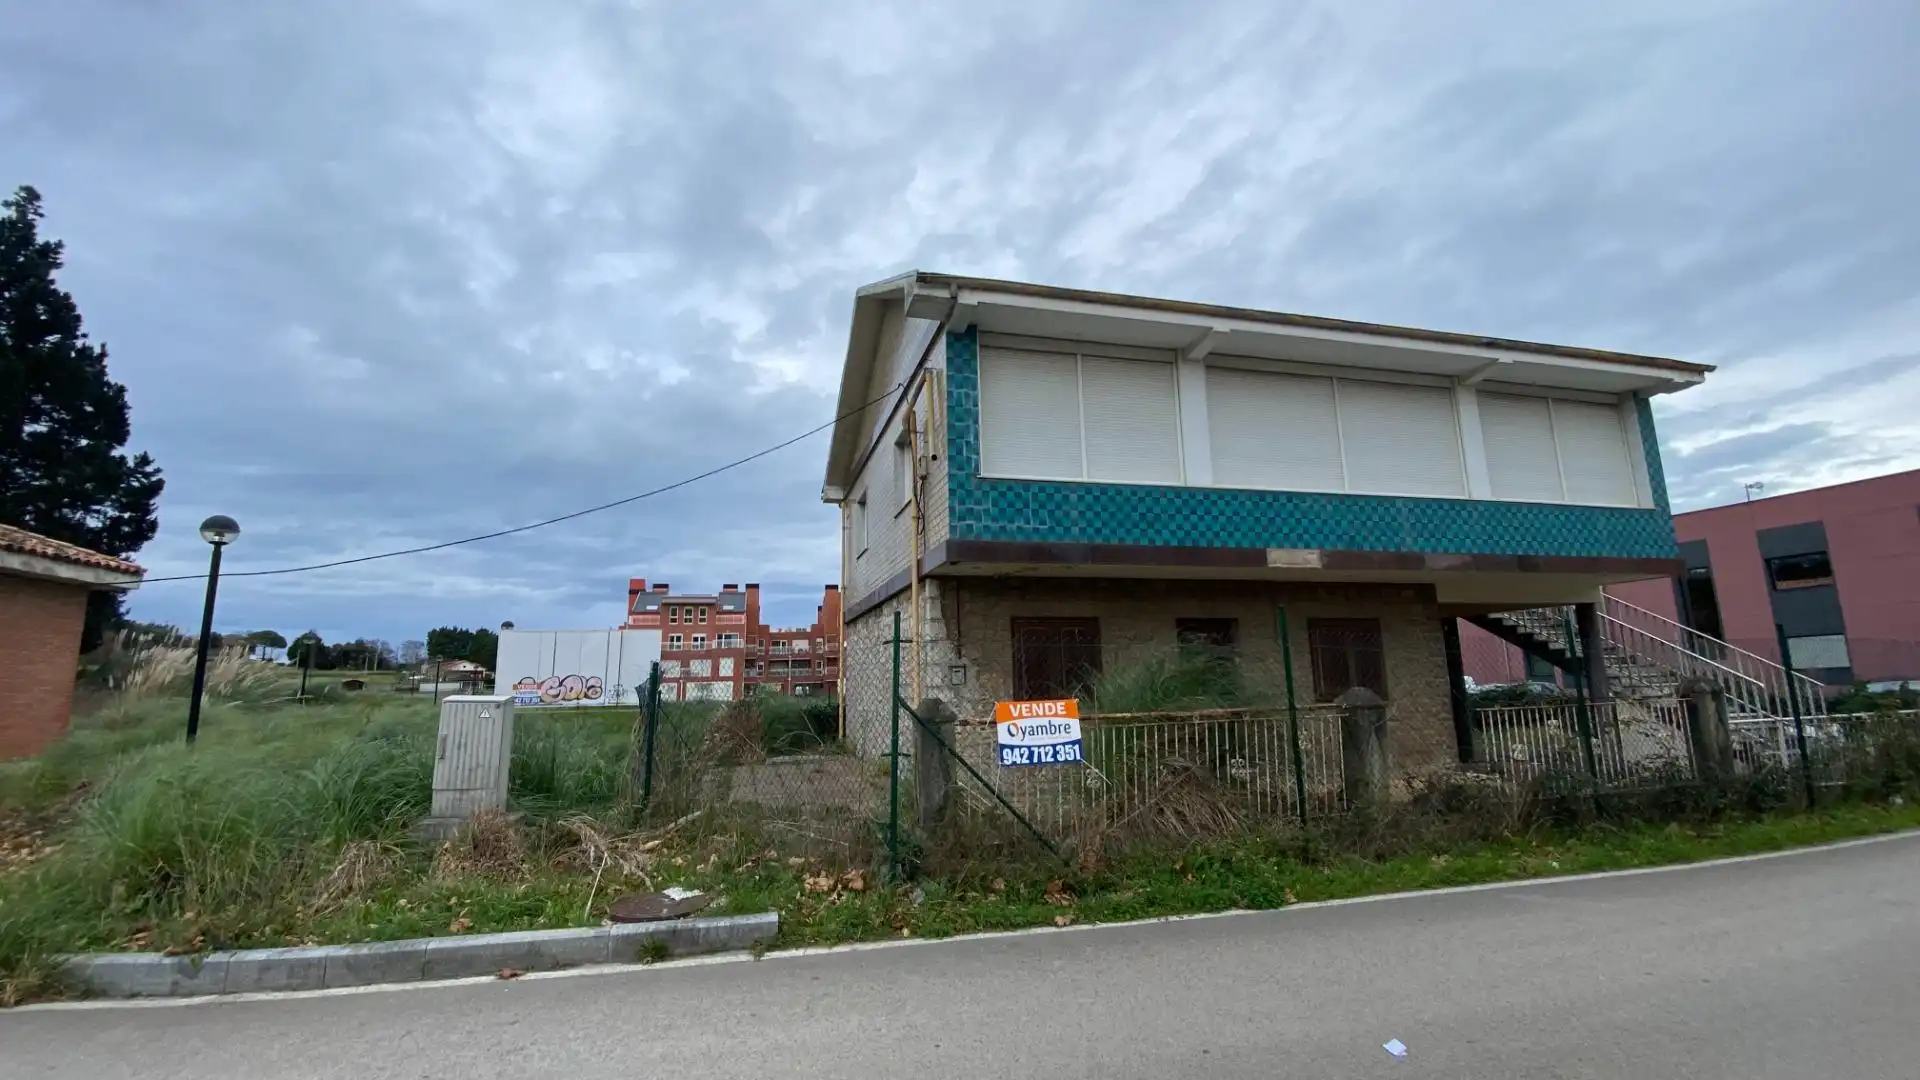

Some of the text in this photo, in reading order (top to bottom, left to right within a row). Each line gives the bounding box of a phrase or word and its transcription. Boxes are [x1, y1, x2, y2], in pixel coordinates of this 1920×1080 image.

[1009, 702, 1067, 717] VENDE
[1007, 720, 1071, 741] Oyambre
[1003, 744, 1081, 765] 942 712 351
